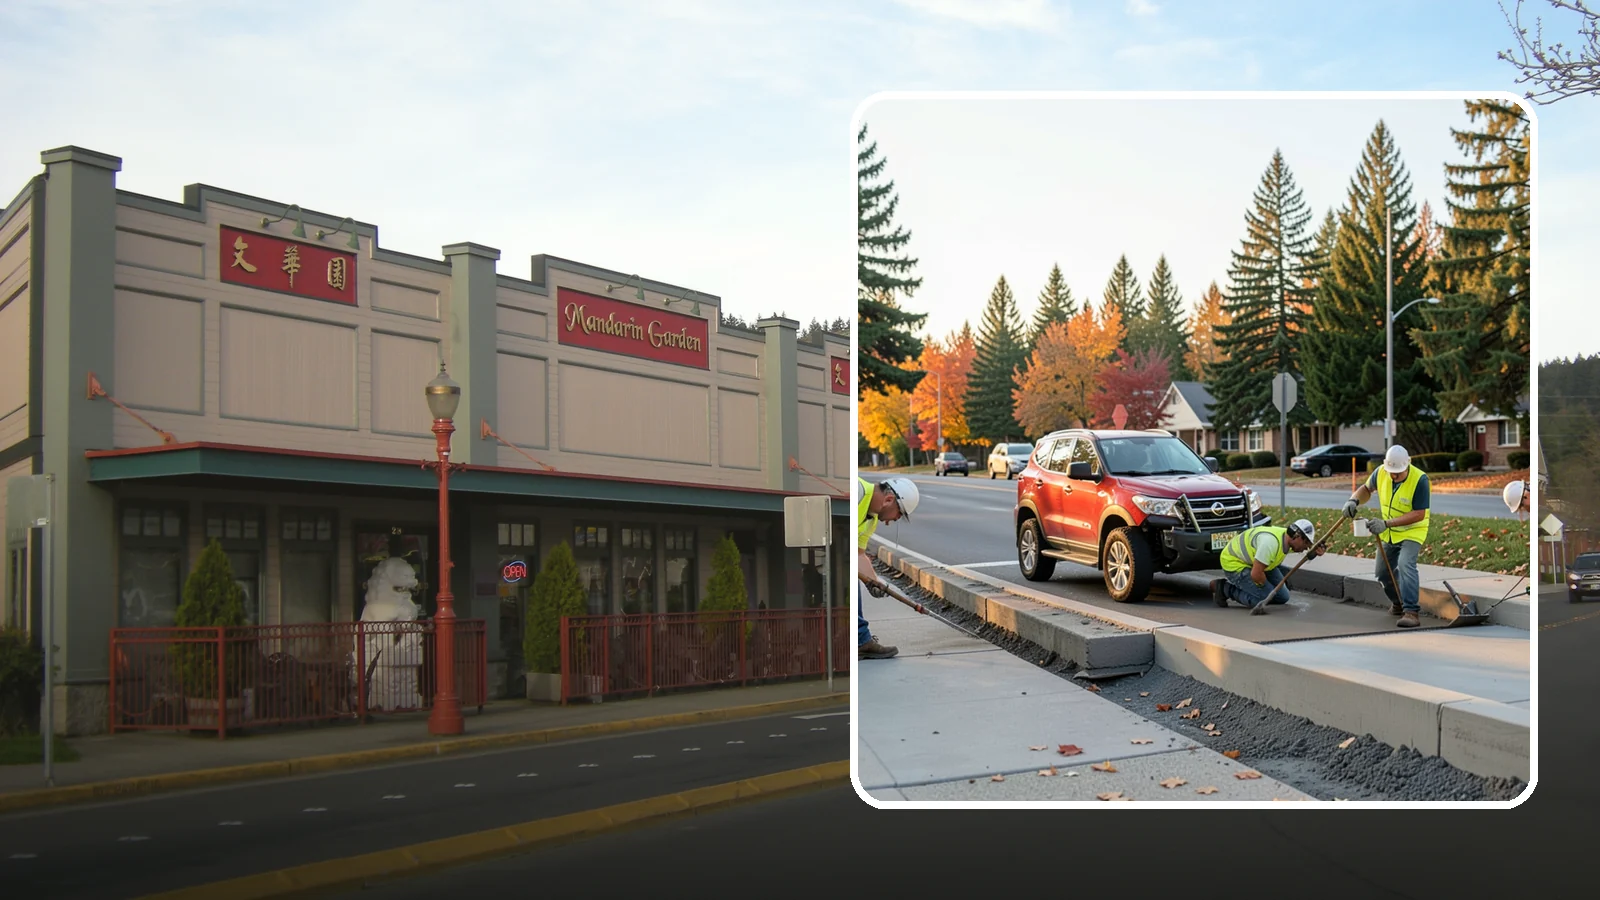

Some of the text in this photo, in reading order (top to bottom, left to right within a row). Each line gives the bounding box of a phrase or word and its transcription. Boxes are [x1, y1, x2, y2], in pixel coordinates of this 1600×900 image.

[231, 235, 346, 291] 文華園
[564, 302, 702, 352] Mandarin Garden
[503, 565, 527, 578] OPEN
